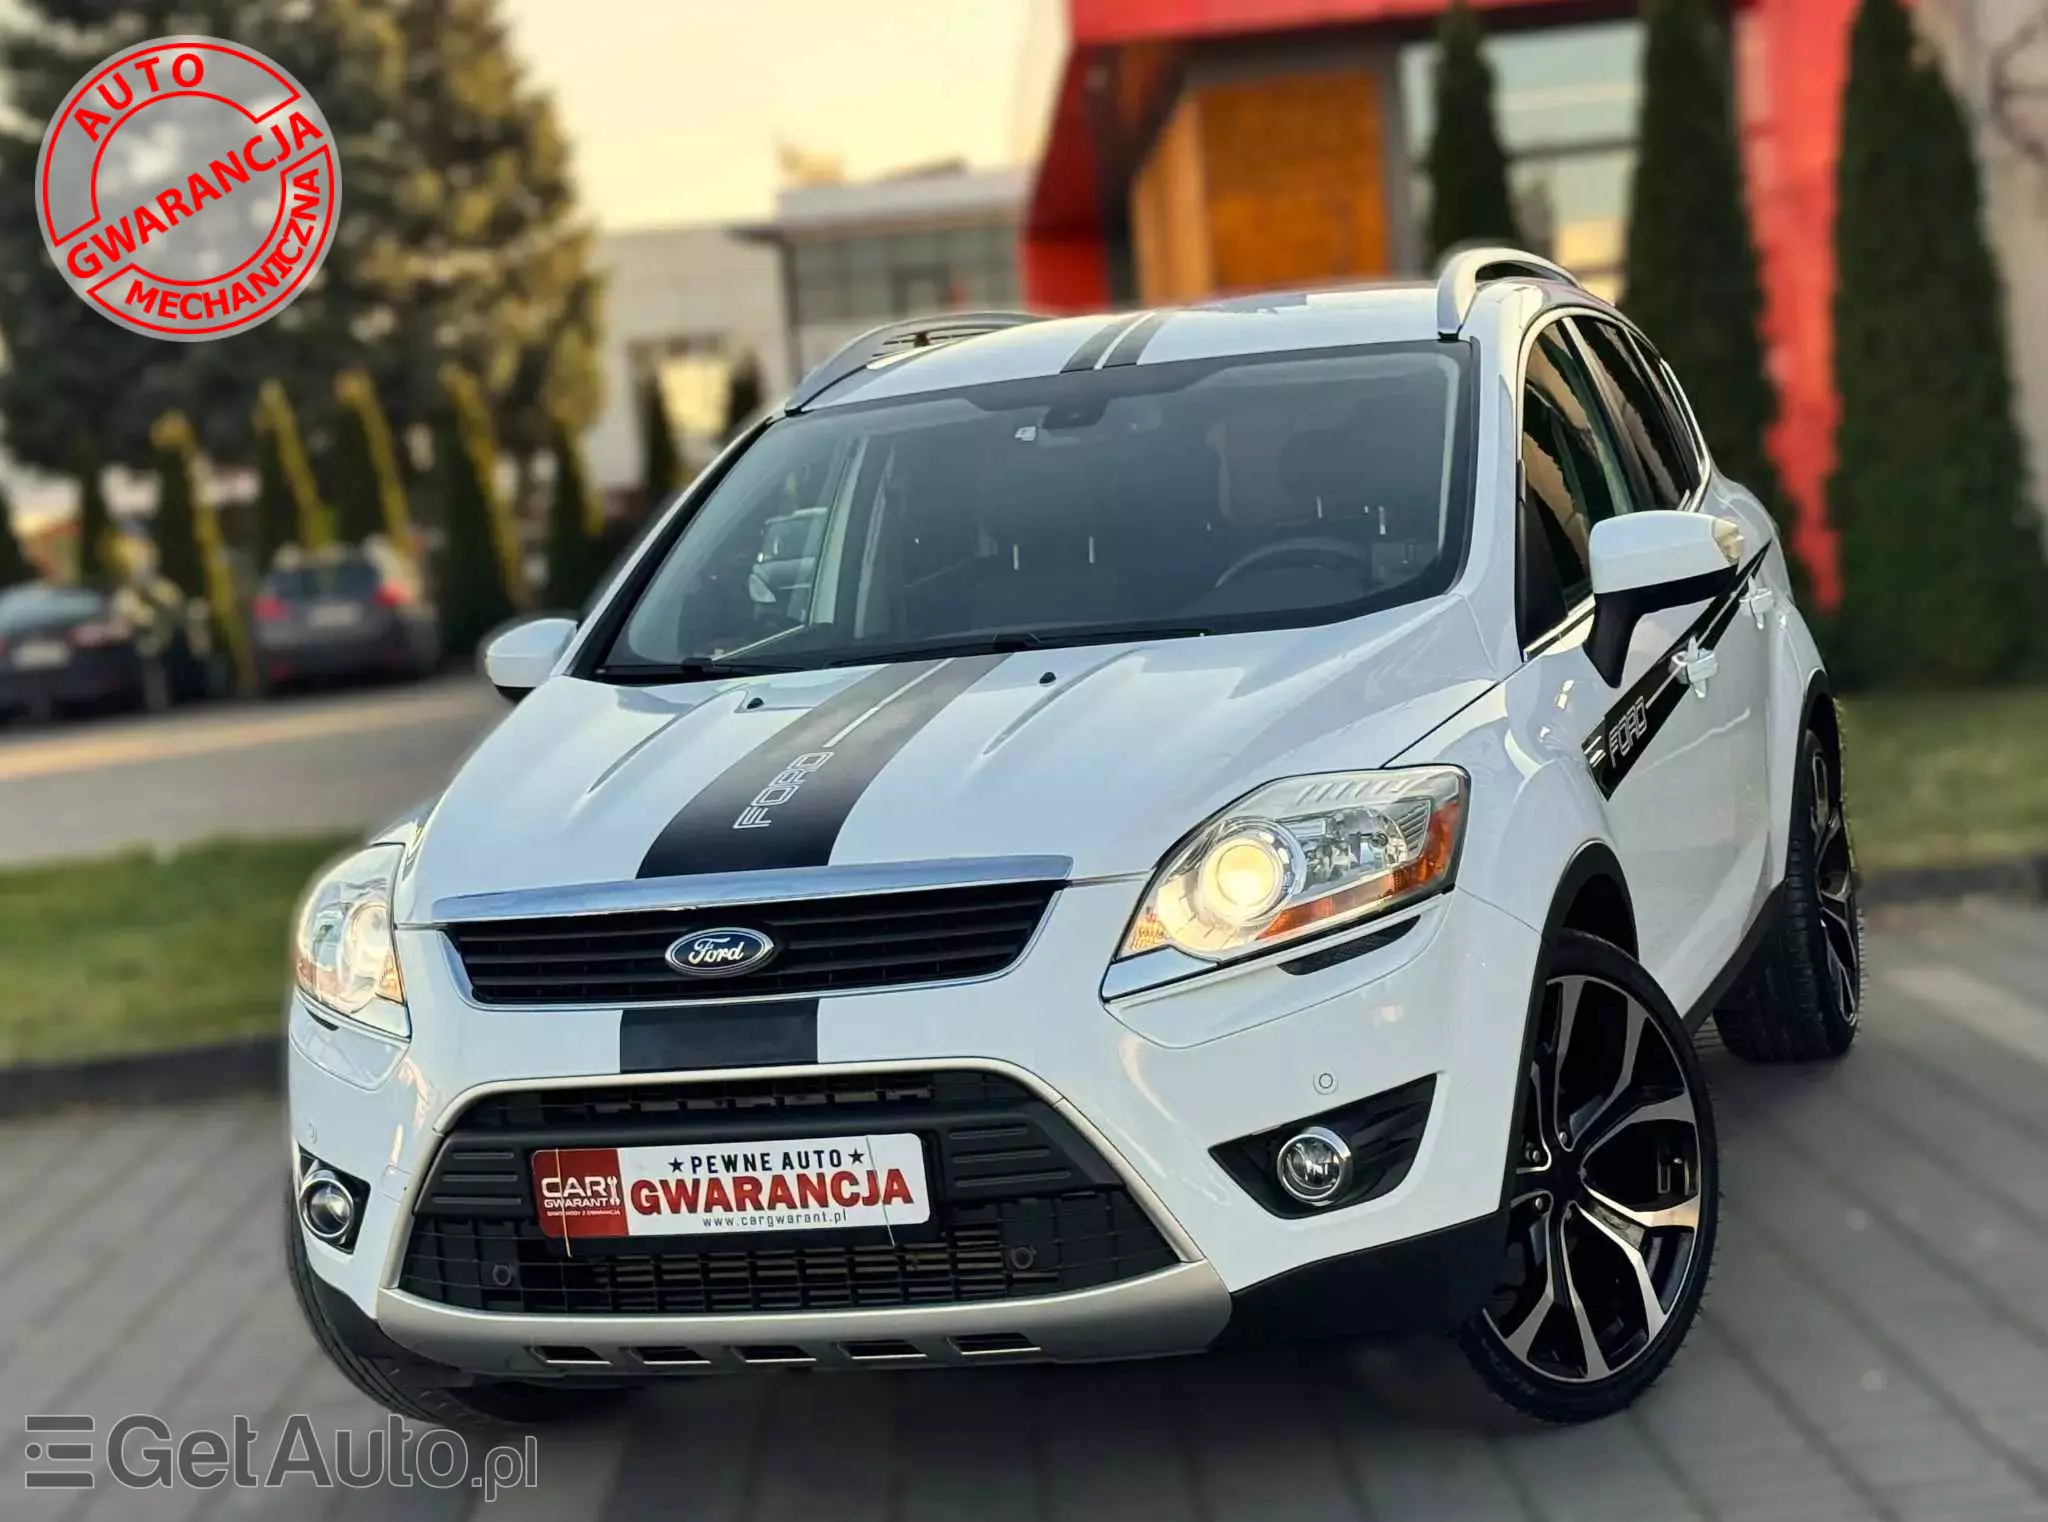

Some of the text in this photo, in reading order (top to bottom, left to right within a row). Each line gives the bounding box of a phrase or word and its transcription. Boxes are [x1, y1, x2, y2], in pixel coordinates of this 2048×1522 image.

[1608, 695, 1648, 769] FORD
[732, 751, 834, 829] FORD
[688, 937, 744, 964] Ford
[691, 1149, 842, 1174] PEWNE AUTO
[544, 1198, 609, 1208] GWARANT
[630, 1168, 912, 1216] GWARANCJA
[703, 1209, 847, 1229] www.cargwarant.pl
